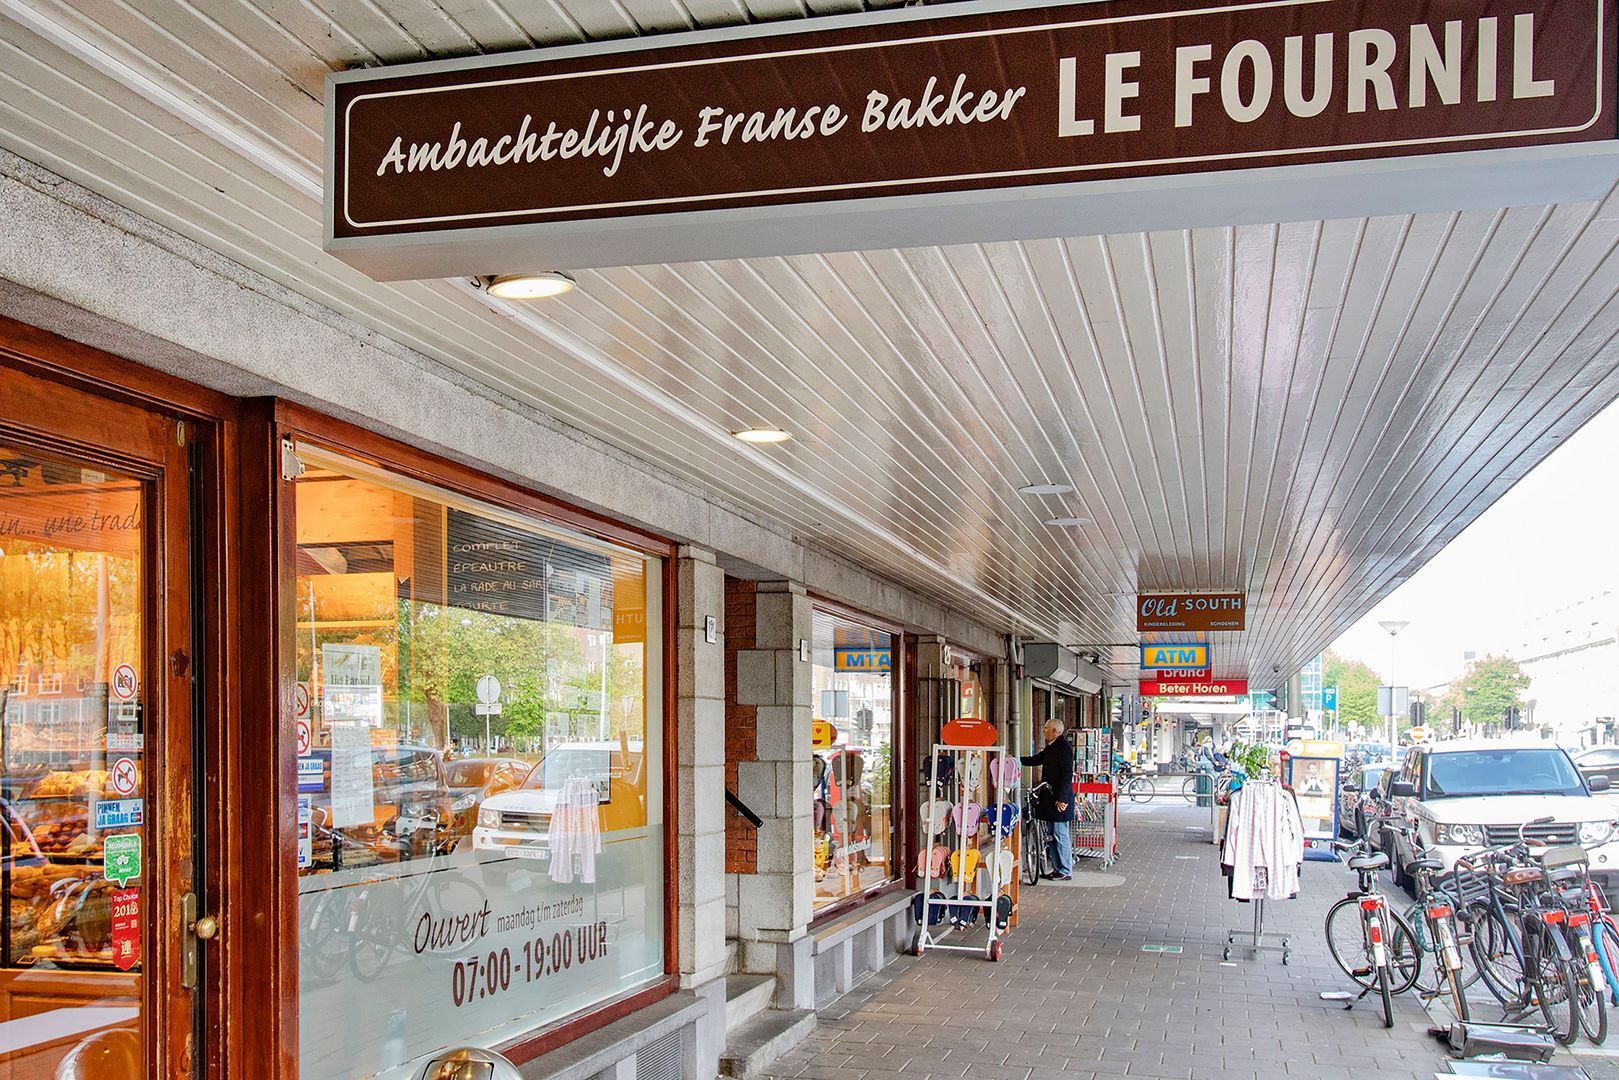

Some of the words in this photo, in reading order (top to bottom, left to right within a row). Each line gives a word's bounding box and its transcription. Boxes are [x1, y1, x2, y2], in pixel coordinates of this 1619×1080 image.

[376, 103, 683, 178] Ambachtelijke
[694, 97, 849, 149] Franse
[861, 73, 1026, 135] Bakker
[1058, 50, 1142, 138] LE
[1174, 12, 1555, 129] FOURNIL
[1141, 598, 1177, 617] Old
[1154, 650, 1196, 664] ATM
[1159, 682, 1191, 694] Beter
[1193, 682, 1227, 694] Horen
[113, 901, 139, 918] 2018
[414, 899, 492, 954] Ouvert
[497, 905, 535, 933] maandag
[536, 902, 551, 924] t/m
[552, 893, 583, 920] zaterdag
[577, 920, 607, 965] UUR
